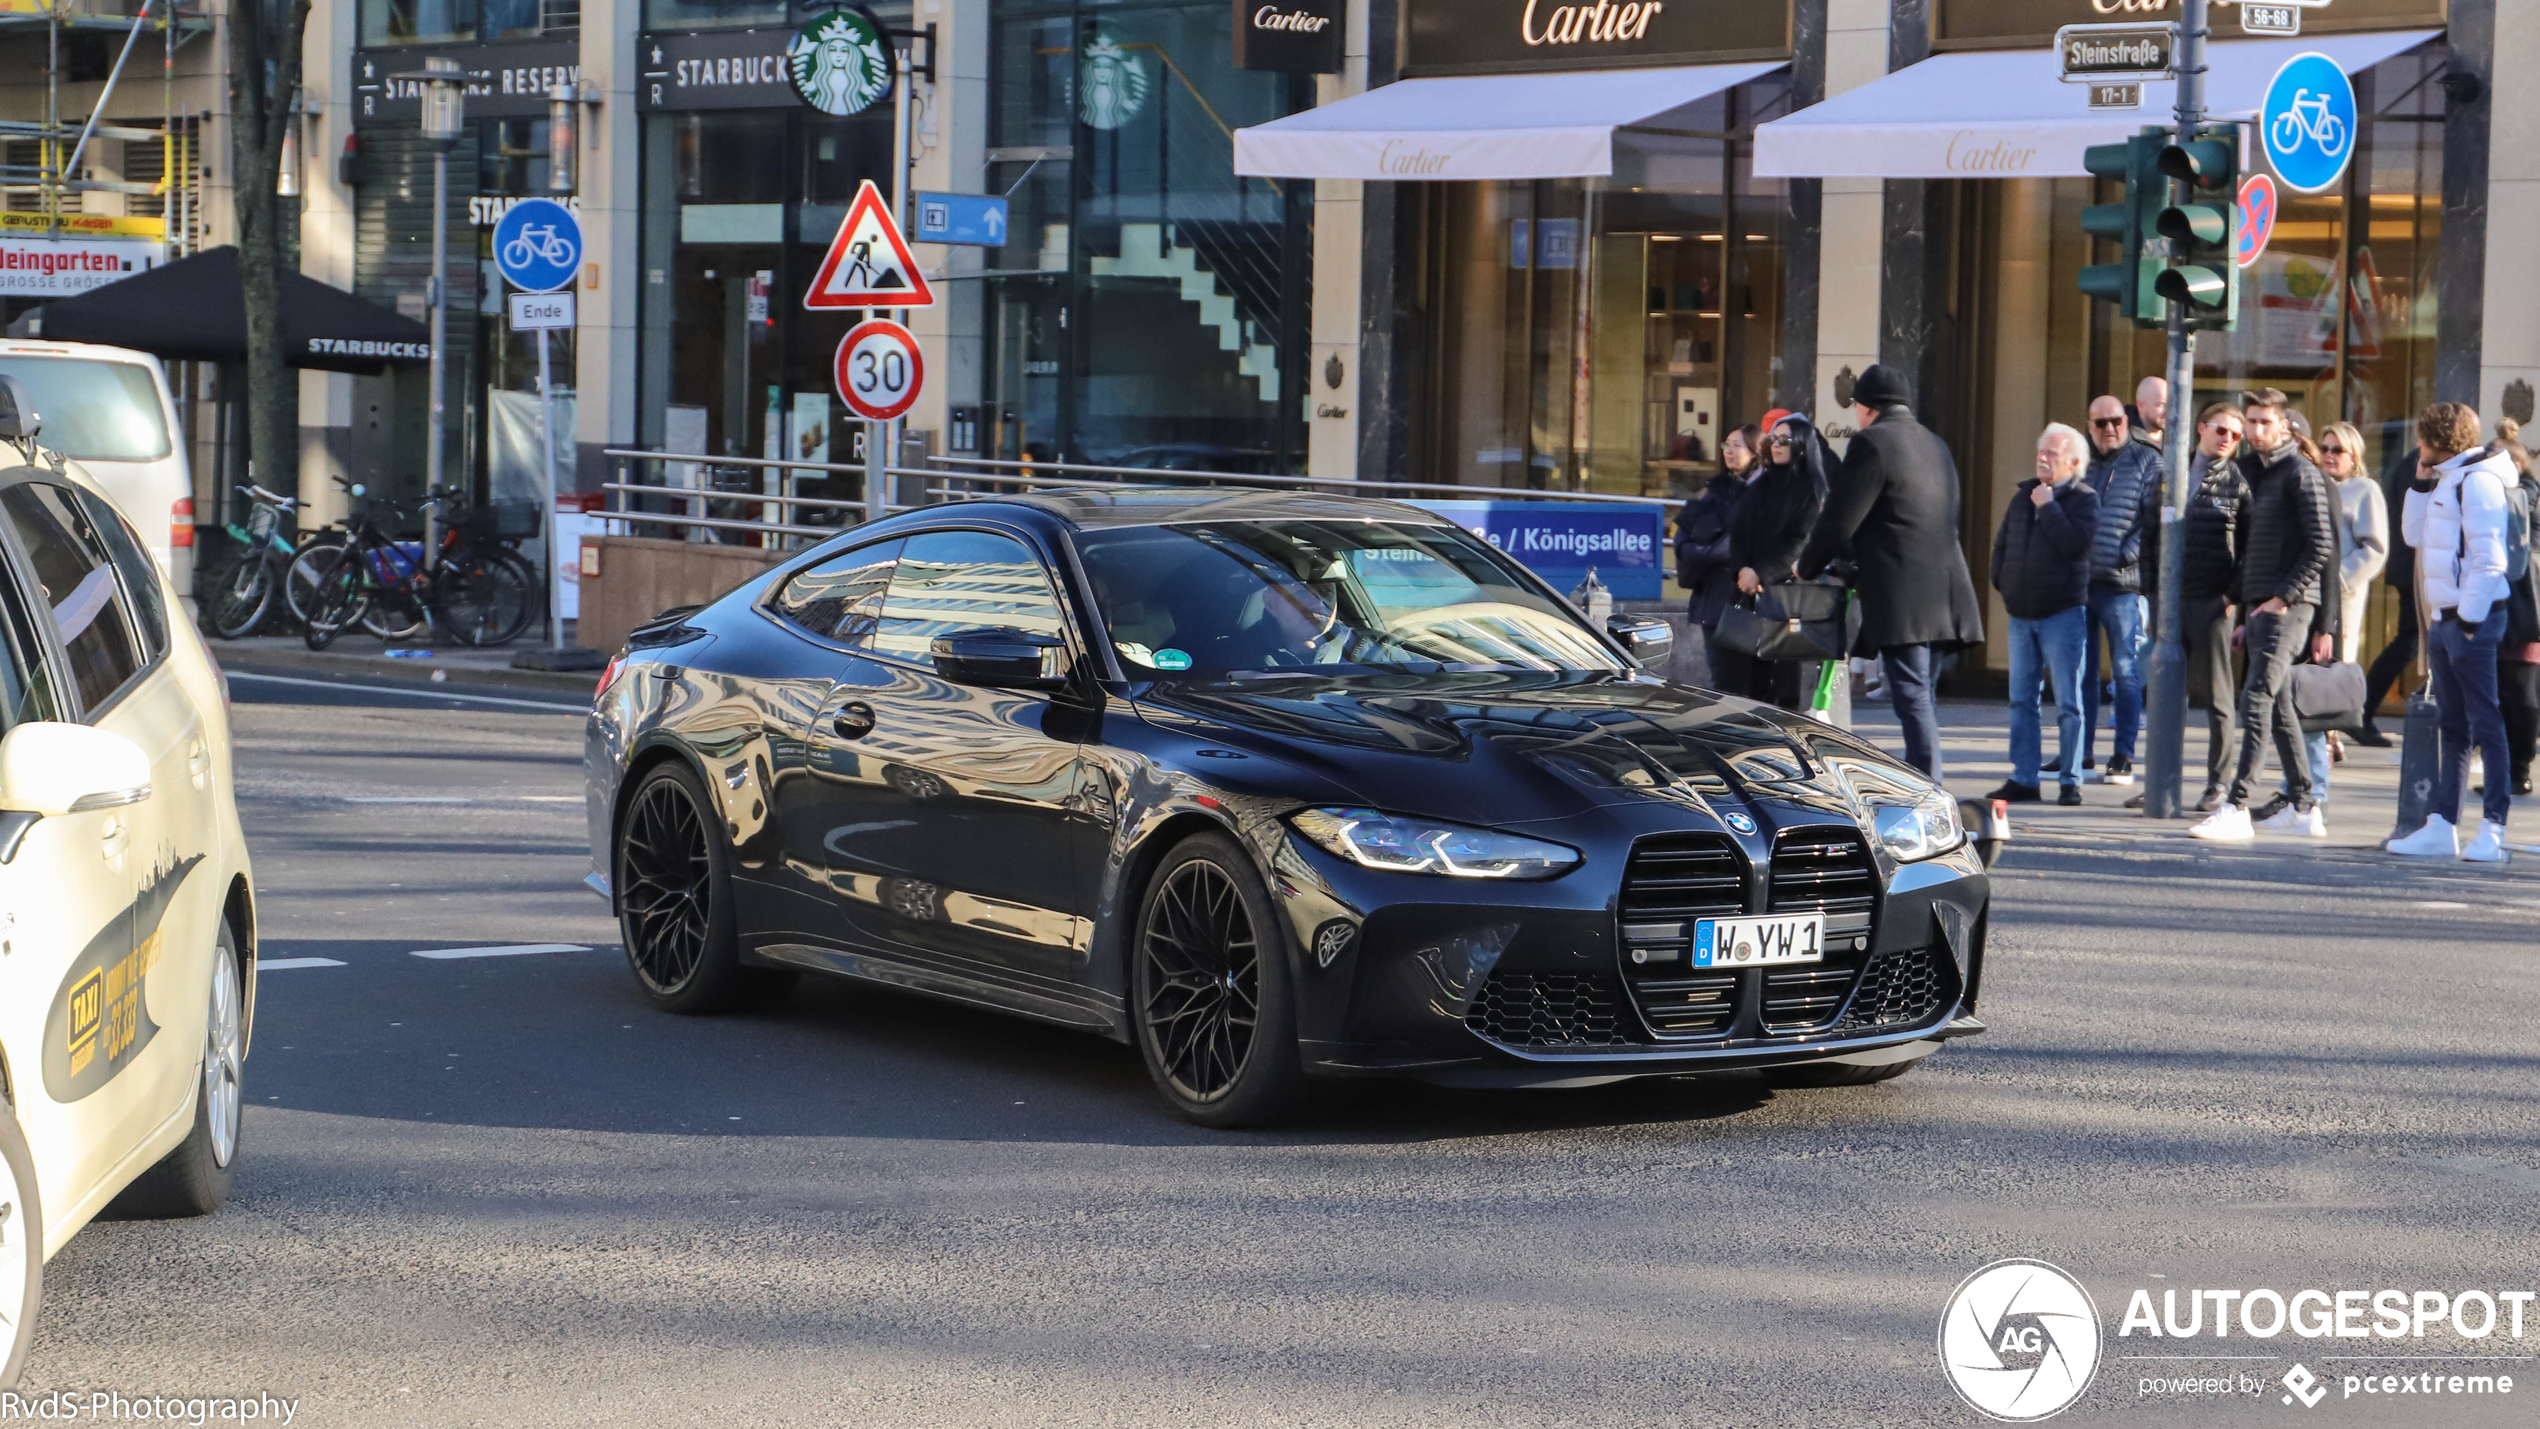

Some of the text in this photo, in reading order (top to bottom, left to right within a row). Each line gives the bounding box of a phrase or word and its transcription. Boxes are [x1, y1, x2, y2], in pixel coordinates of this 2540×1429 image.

[1253, 5, 1331, 34] Cartier
[2254, 8, 2289, 26] 56-68
[2071, 39, 2160, 66] Steinstraße
[676, 54, 790, 88] STARBUCK
[2101, 87, 2127, 103] 17-1
[1379, 138, 1451, 174] Cartier
[1945, 128, 2037, 171] Cartier
[0, 247, 119, 276] eingarten
[523, 304, 562, 319] Ende
[308, 338, 430, 359] STARBUCKS
[856, 350, 905, 393] 30
[1317, 402, 1348, 419] Cartier
[1524, 528, 1652, 556] Königsallee
[1699, 948, 1708, 959] D
[1717, 925, 1736, 960] W
[73, 982, 99, 1035] TAXI
